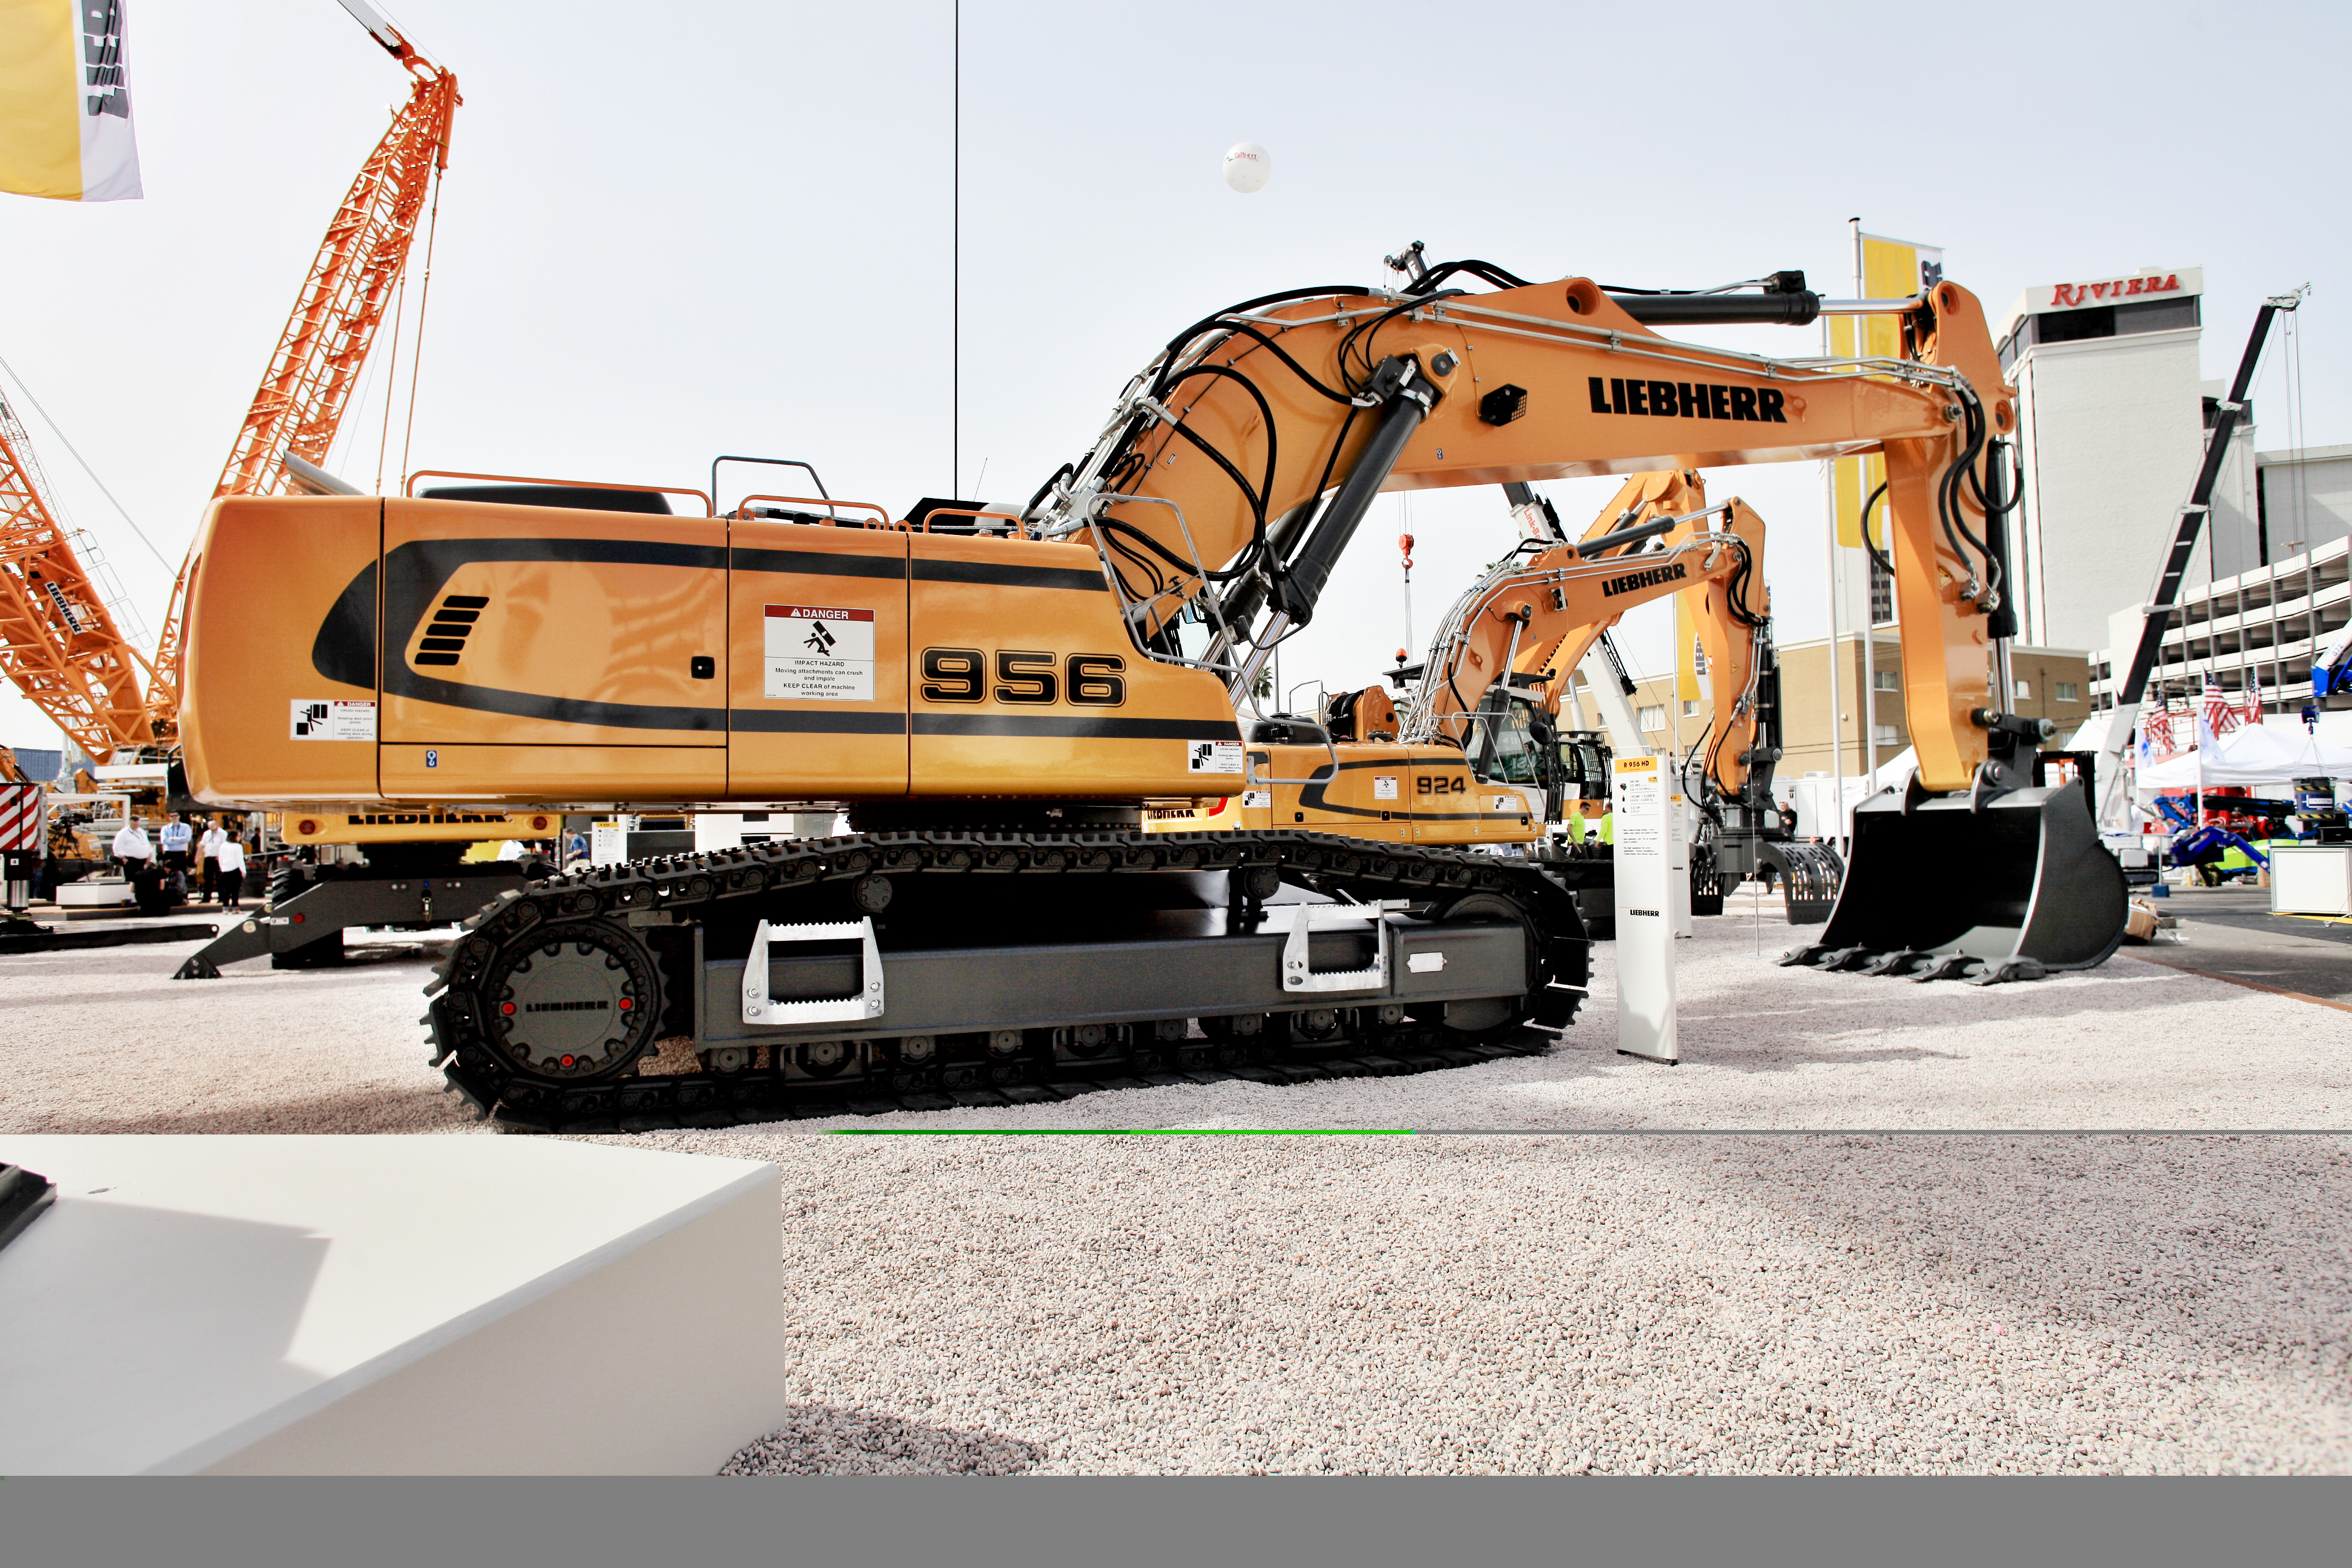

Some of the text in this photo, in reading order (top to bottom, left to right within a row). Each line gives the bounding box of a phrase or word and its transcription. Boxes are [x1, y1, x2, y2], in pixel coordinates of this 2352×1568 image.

[1588, 376, 1788, 423] LIEBHERR
[1601, 563, 1687, 597] LIEBHERR
[46, 582, 82, 635] LIEBHERR
[803, 609, 849, 620] DANGER
[921, 646, 1126, 708] 956
[1417, 776, 1467, 795] 924
[526, 1000, 609, 1012] LIEBHERR
